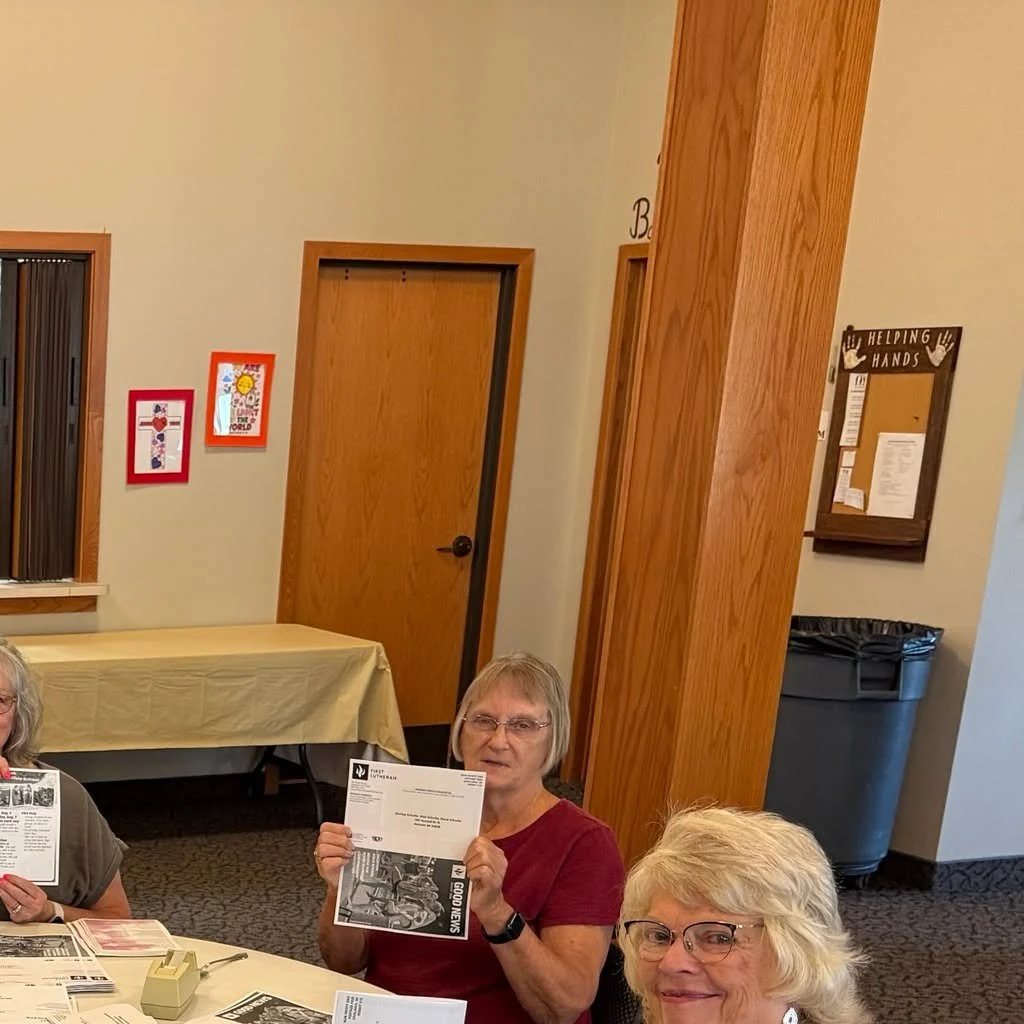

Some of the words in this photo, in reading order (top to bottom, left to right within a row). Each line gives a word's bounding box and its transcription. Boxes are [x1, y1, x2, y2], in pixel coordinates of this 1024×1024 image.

[868, 328, 932, 346] HELPING
[871, 351, 920, 369] HANDS
[370, 773, 398, 781] LUTHERAN
[452, 882, 465, 906] GOOD
[449, 907, 462, 934] NEWS
